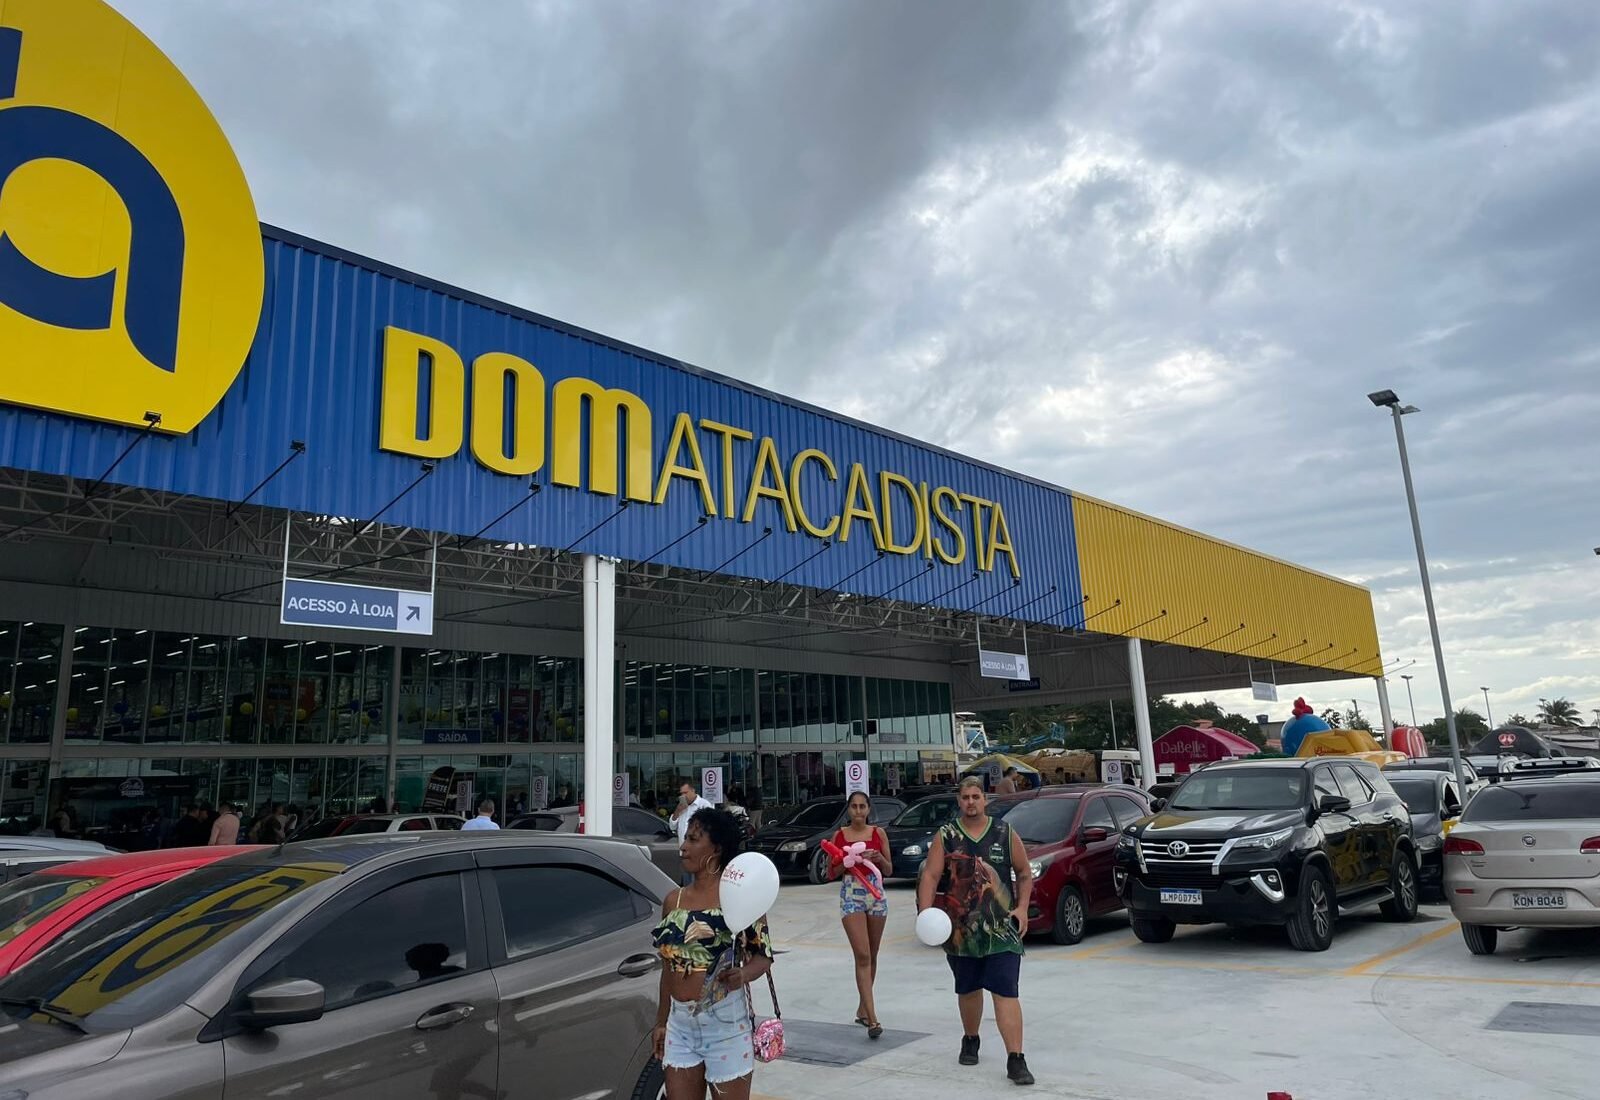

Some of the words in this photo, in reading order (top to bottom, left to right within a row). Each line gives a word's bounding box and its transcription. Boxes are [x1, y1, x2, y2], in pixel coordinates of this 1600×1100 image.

[379, 325, 652, 504] DOM
[652, 412, 1021, 579] ATACADISTA
[287, 596, 347, 614] ACESSO
[349, 599, 360, 616] À
[363, 603, 395, 618] LOJA
[982, 660, 1001, 670] ACESSO
[1010, 680, 1038, 689] ENTRADA
[437, 731, 468, 743] SAÍDA
[1160, 740, 1206, 754] DaBelle
